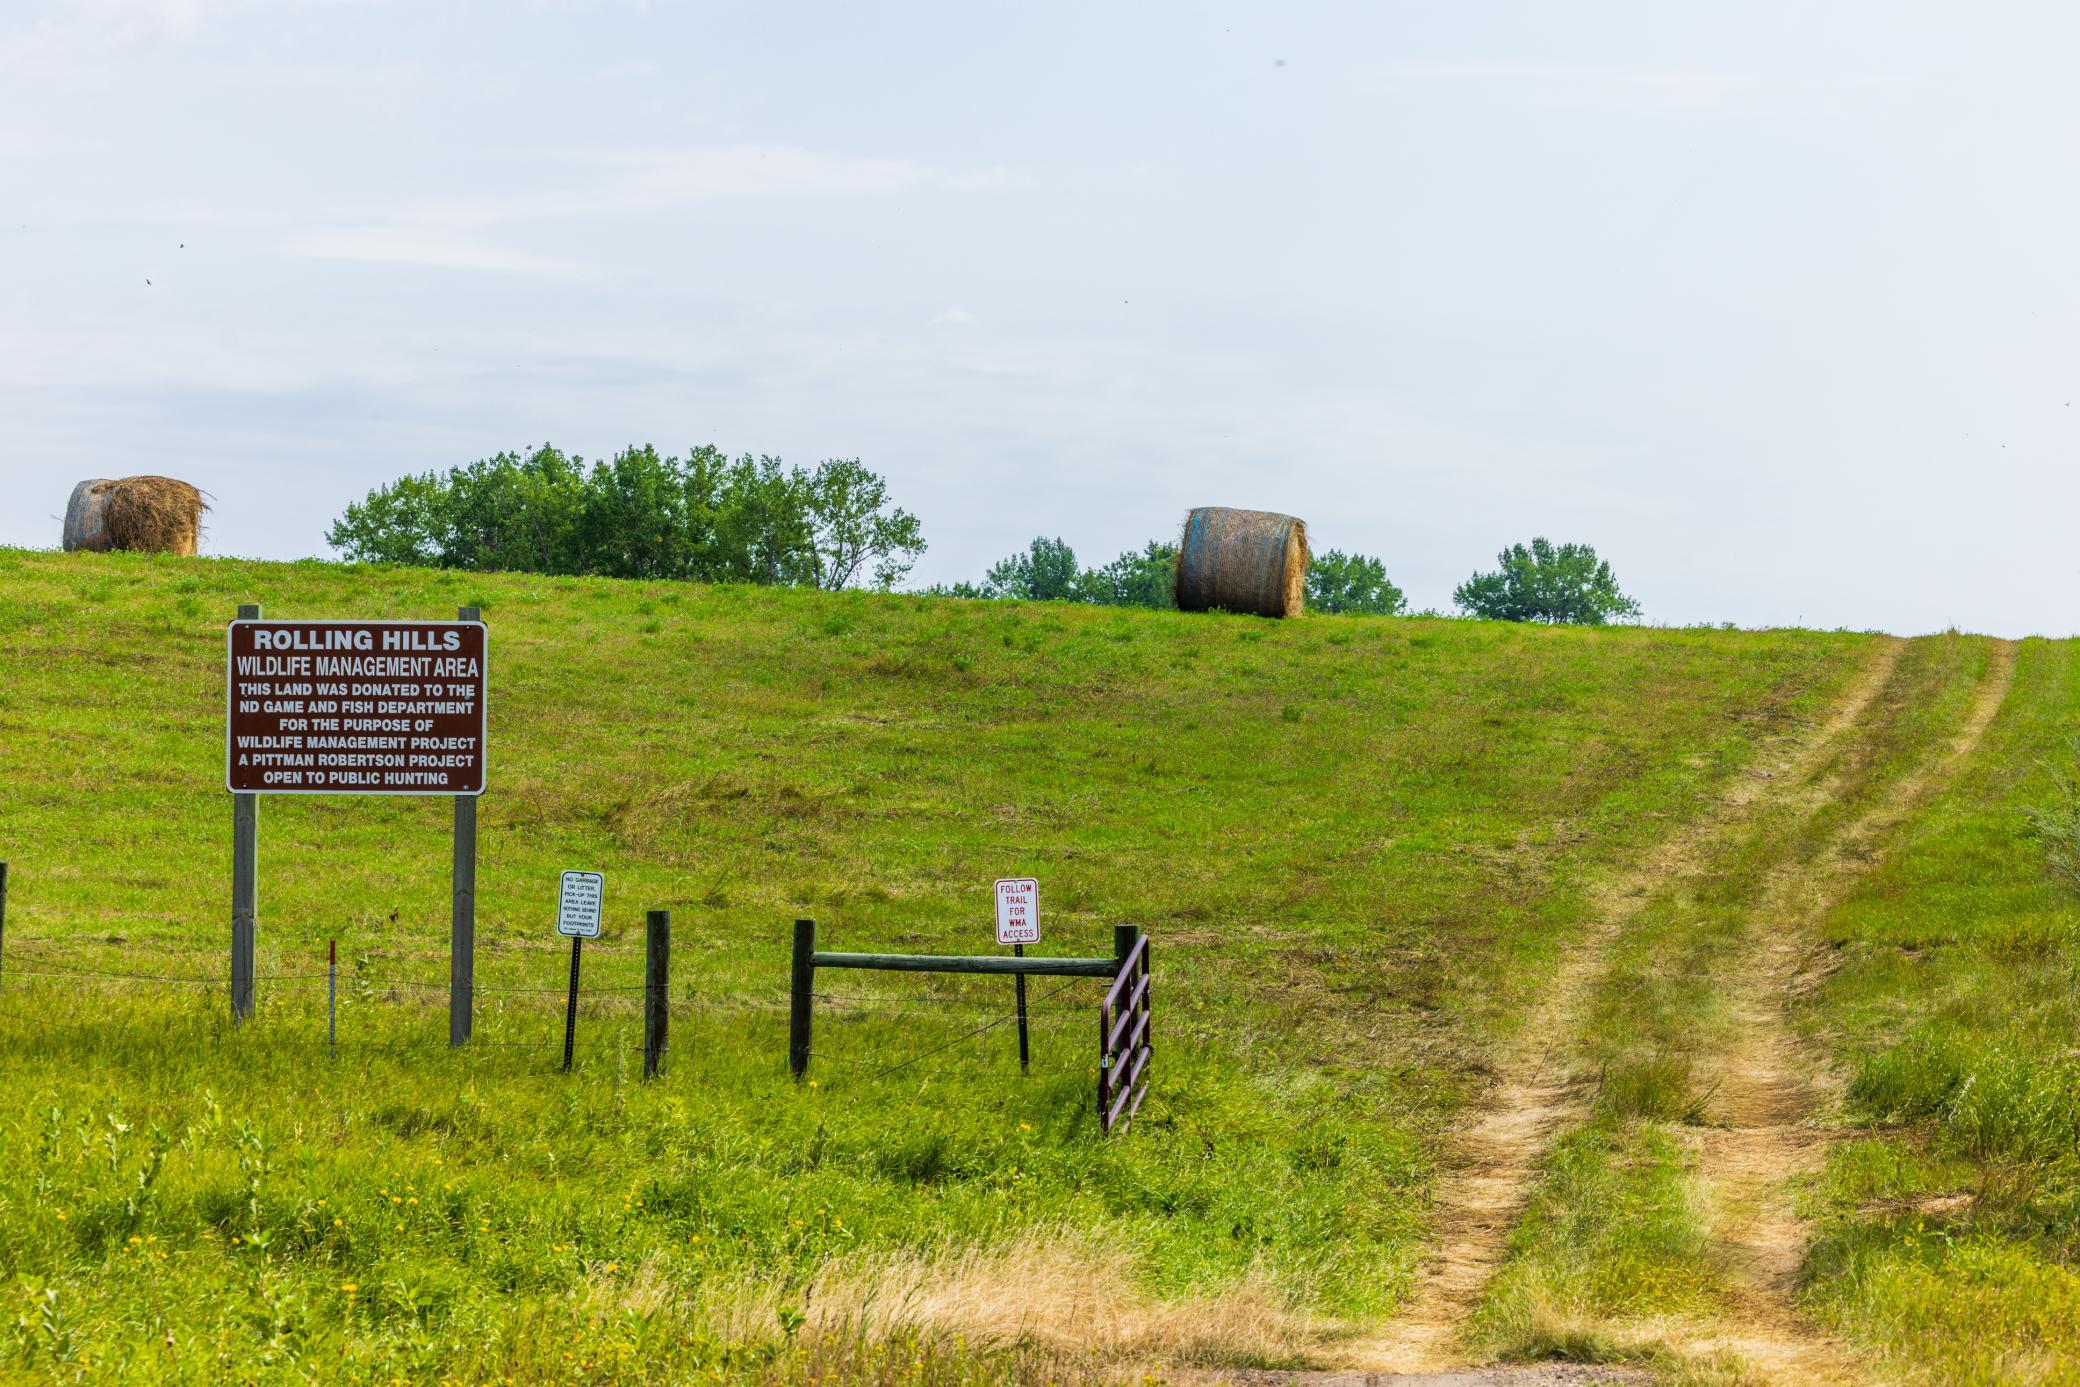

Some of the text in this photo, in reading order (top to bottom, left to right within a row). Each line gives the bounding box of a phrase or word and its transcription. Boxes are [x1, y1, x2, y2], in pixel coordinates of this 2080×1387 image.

[254, 630, 460, 651] ROLLING HILLS
[237, 656, 478, 678] WILDLIFE MANAGEMENT AREA
[239, 683, 475, 697] THIS LAND WAS DONATED TO THE
[240, 701, 474, 714] ND GAME AND FISH DEPARTMENT
[280, 719, 433, 731] FOR THE PURPOSE OF
[237, 736, 475, 750] WILDLIFE MANAGEMENT PROJECT
[238, 754, 474, 767] A PITTMAN ROBERTSON PROJECT
[264, 772, 448, 785] OPEN TO PUBLIC HUNTING
[1001, 884, 1031, 893] FOLLOW
[1006, 896, 1028, 904] TRAIL
[1003, 930, 1033, 938] ACCESS
